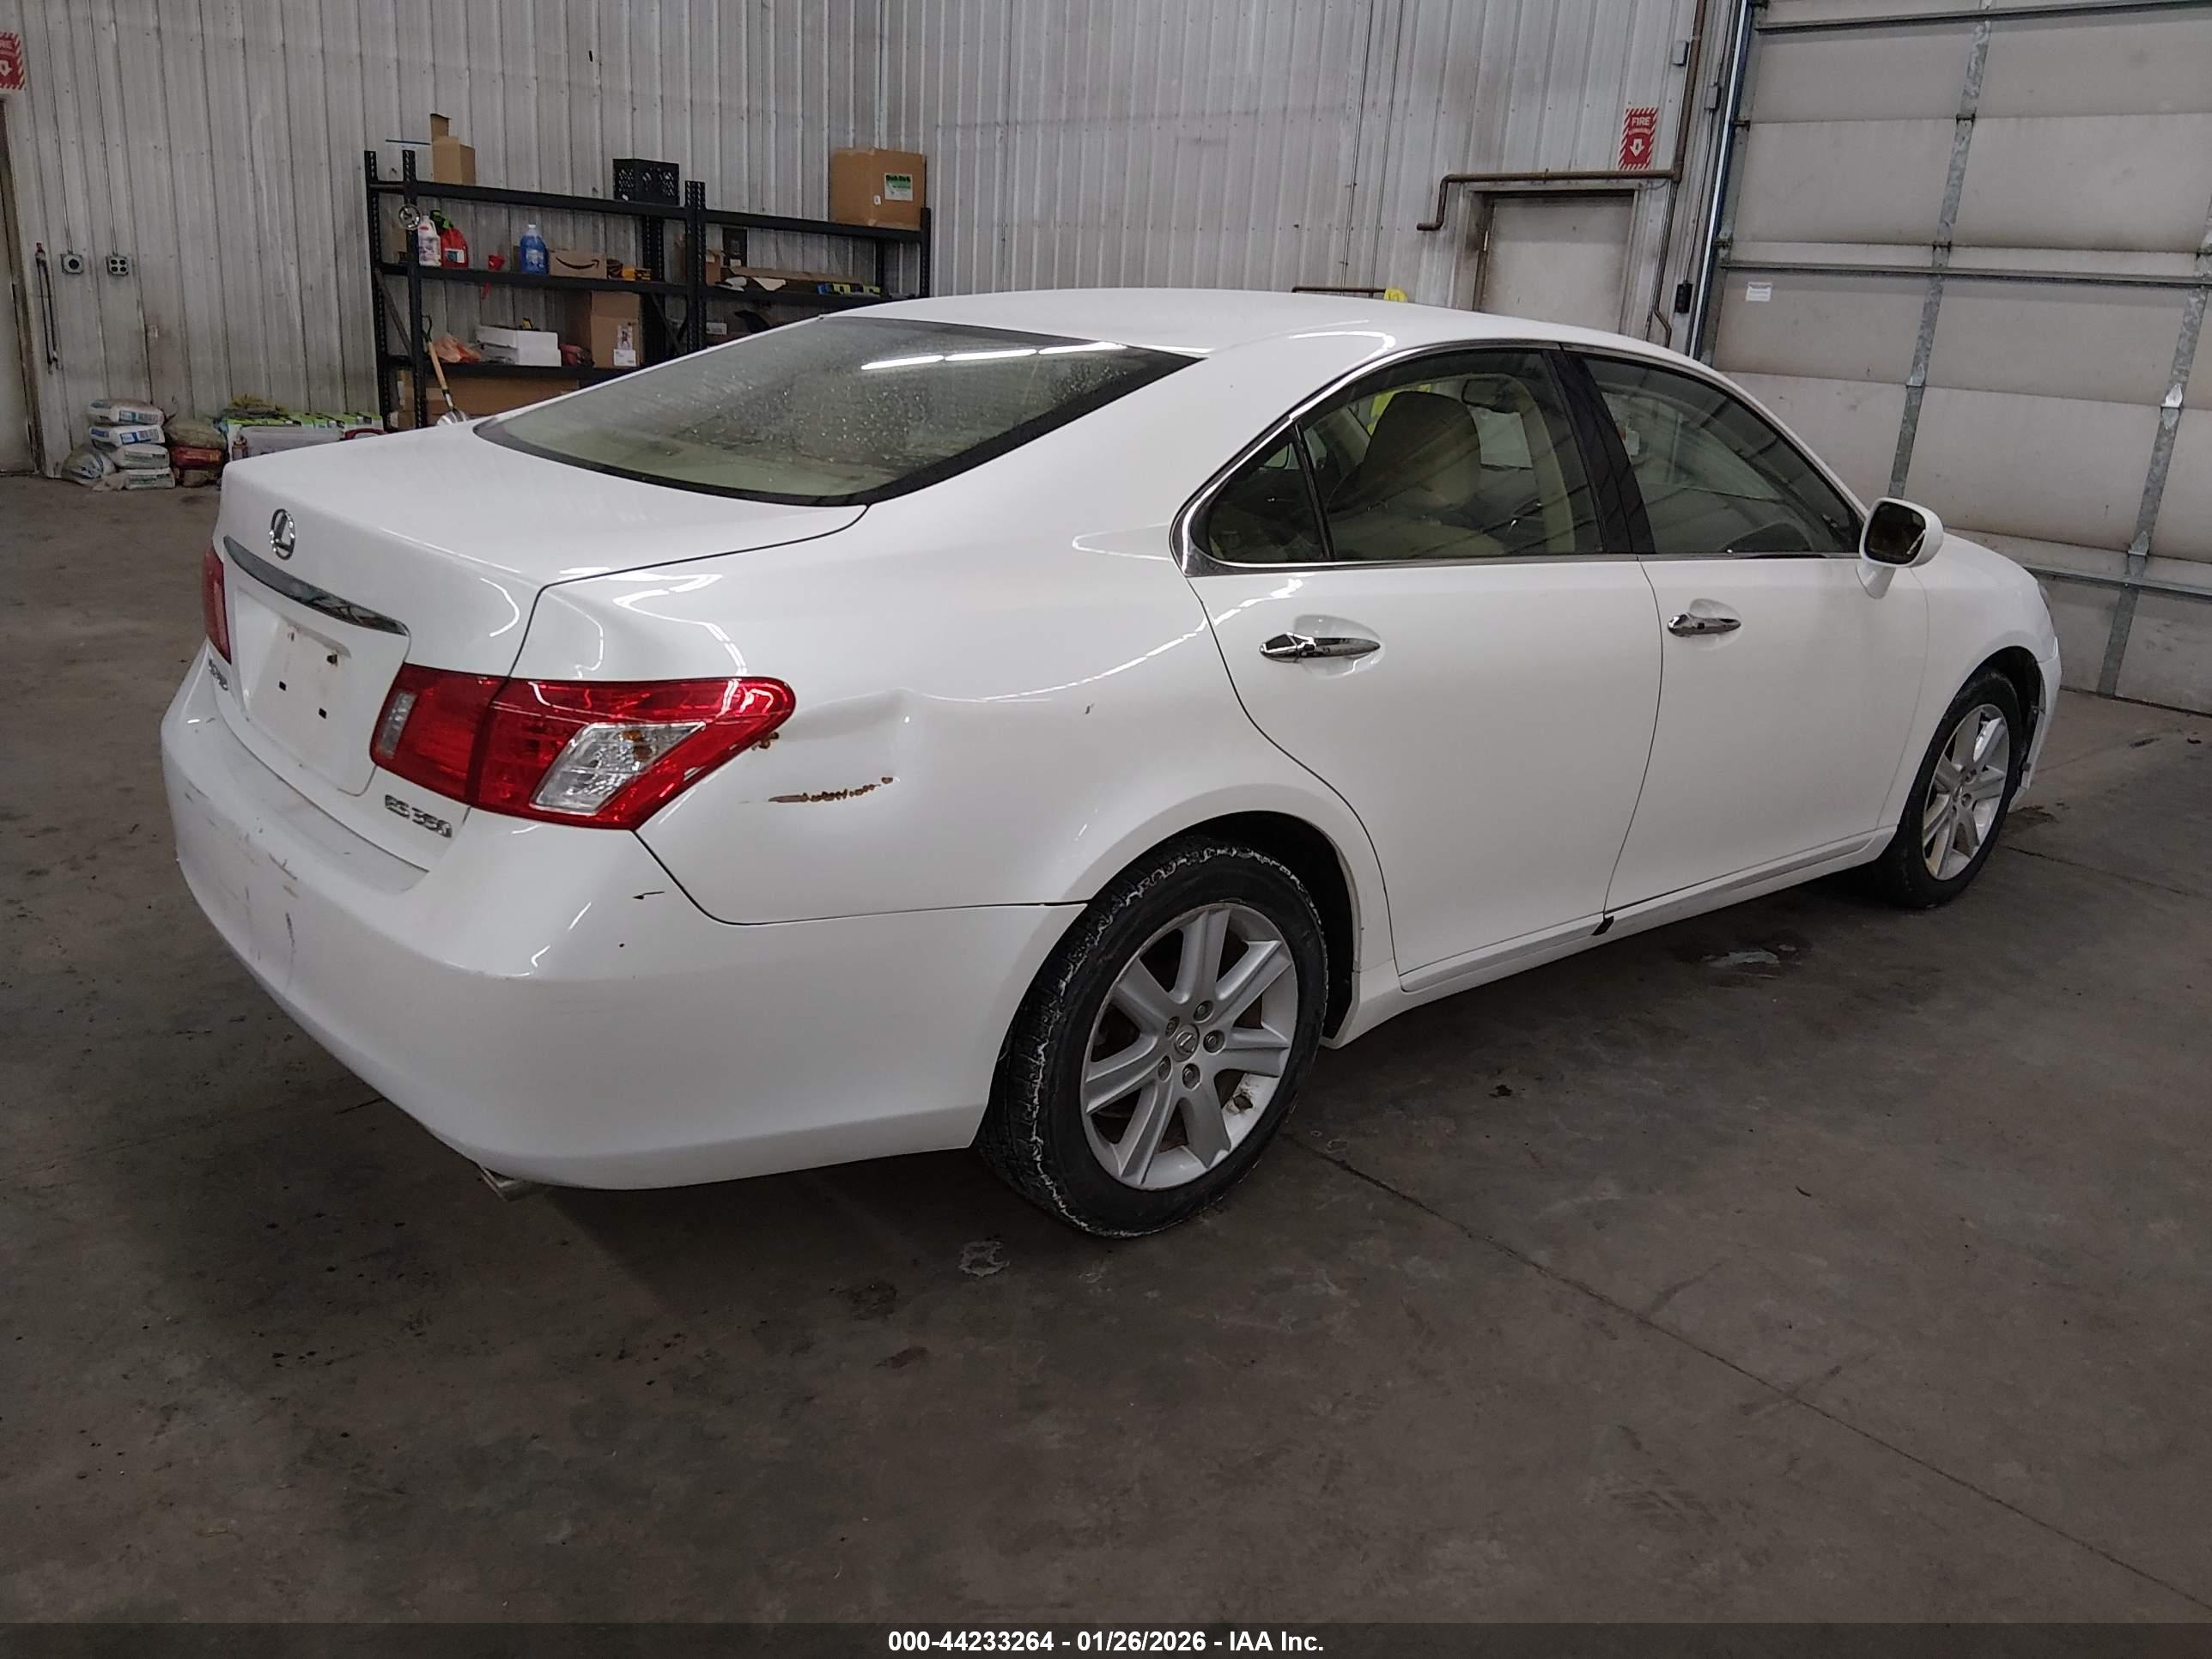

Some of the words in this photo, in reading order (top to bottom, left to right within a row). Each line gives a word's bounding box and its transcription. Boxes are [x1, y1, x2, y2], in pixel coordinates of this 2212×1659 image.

[1632, 117, 1650, 126] FIRE
[385, 794, 410, 819] ES
[411, 807, 453, 838] 350
